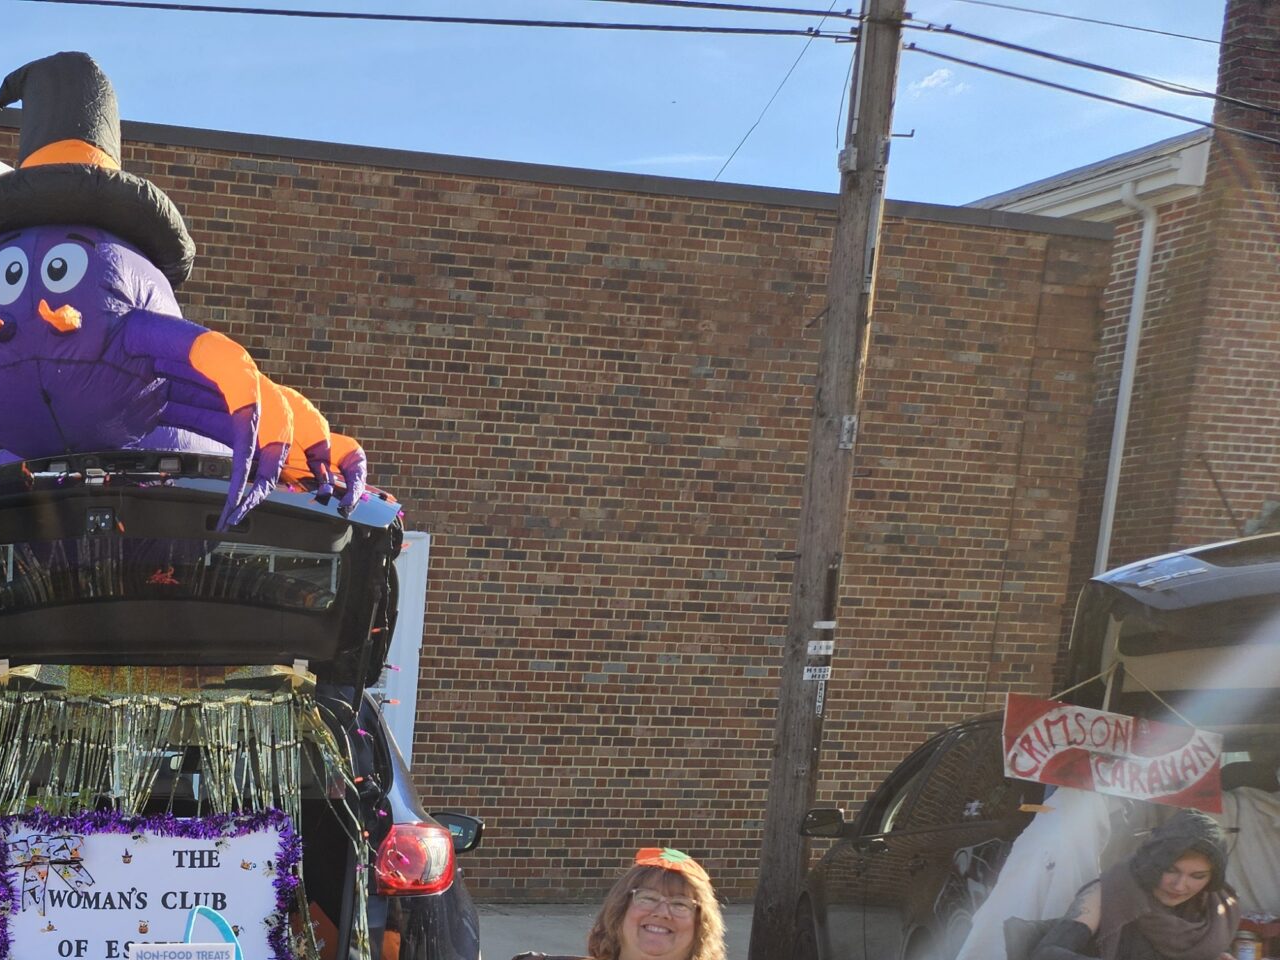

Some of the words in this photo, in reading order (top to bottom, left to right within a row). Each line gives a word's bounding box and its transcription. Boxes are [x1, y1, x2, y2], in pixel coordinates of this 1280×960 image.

[1009, 712, 1130, 778] CRIMSON
[1095, 734, 1216, 794] CARAVAN
[173, 850, 221, 868] THE
[48, 887, 148, 910] WOMAN'S
[161, 891, 227, 910] CLUB
[58, 940, 88, 957] OF
[136, 950, 193, 960] NON-FOOD
[196, 950, 230, 960] TREATS
